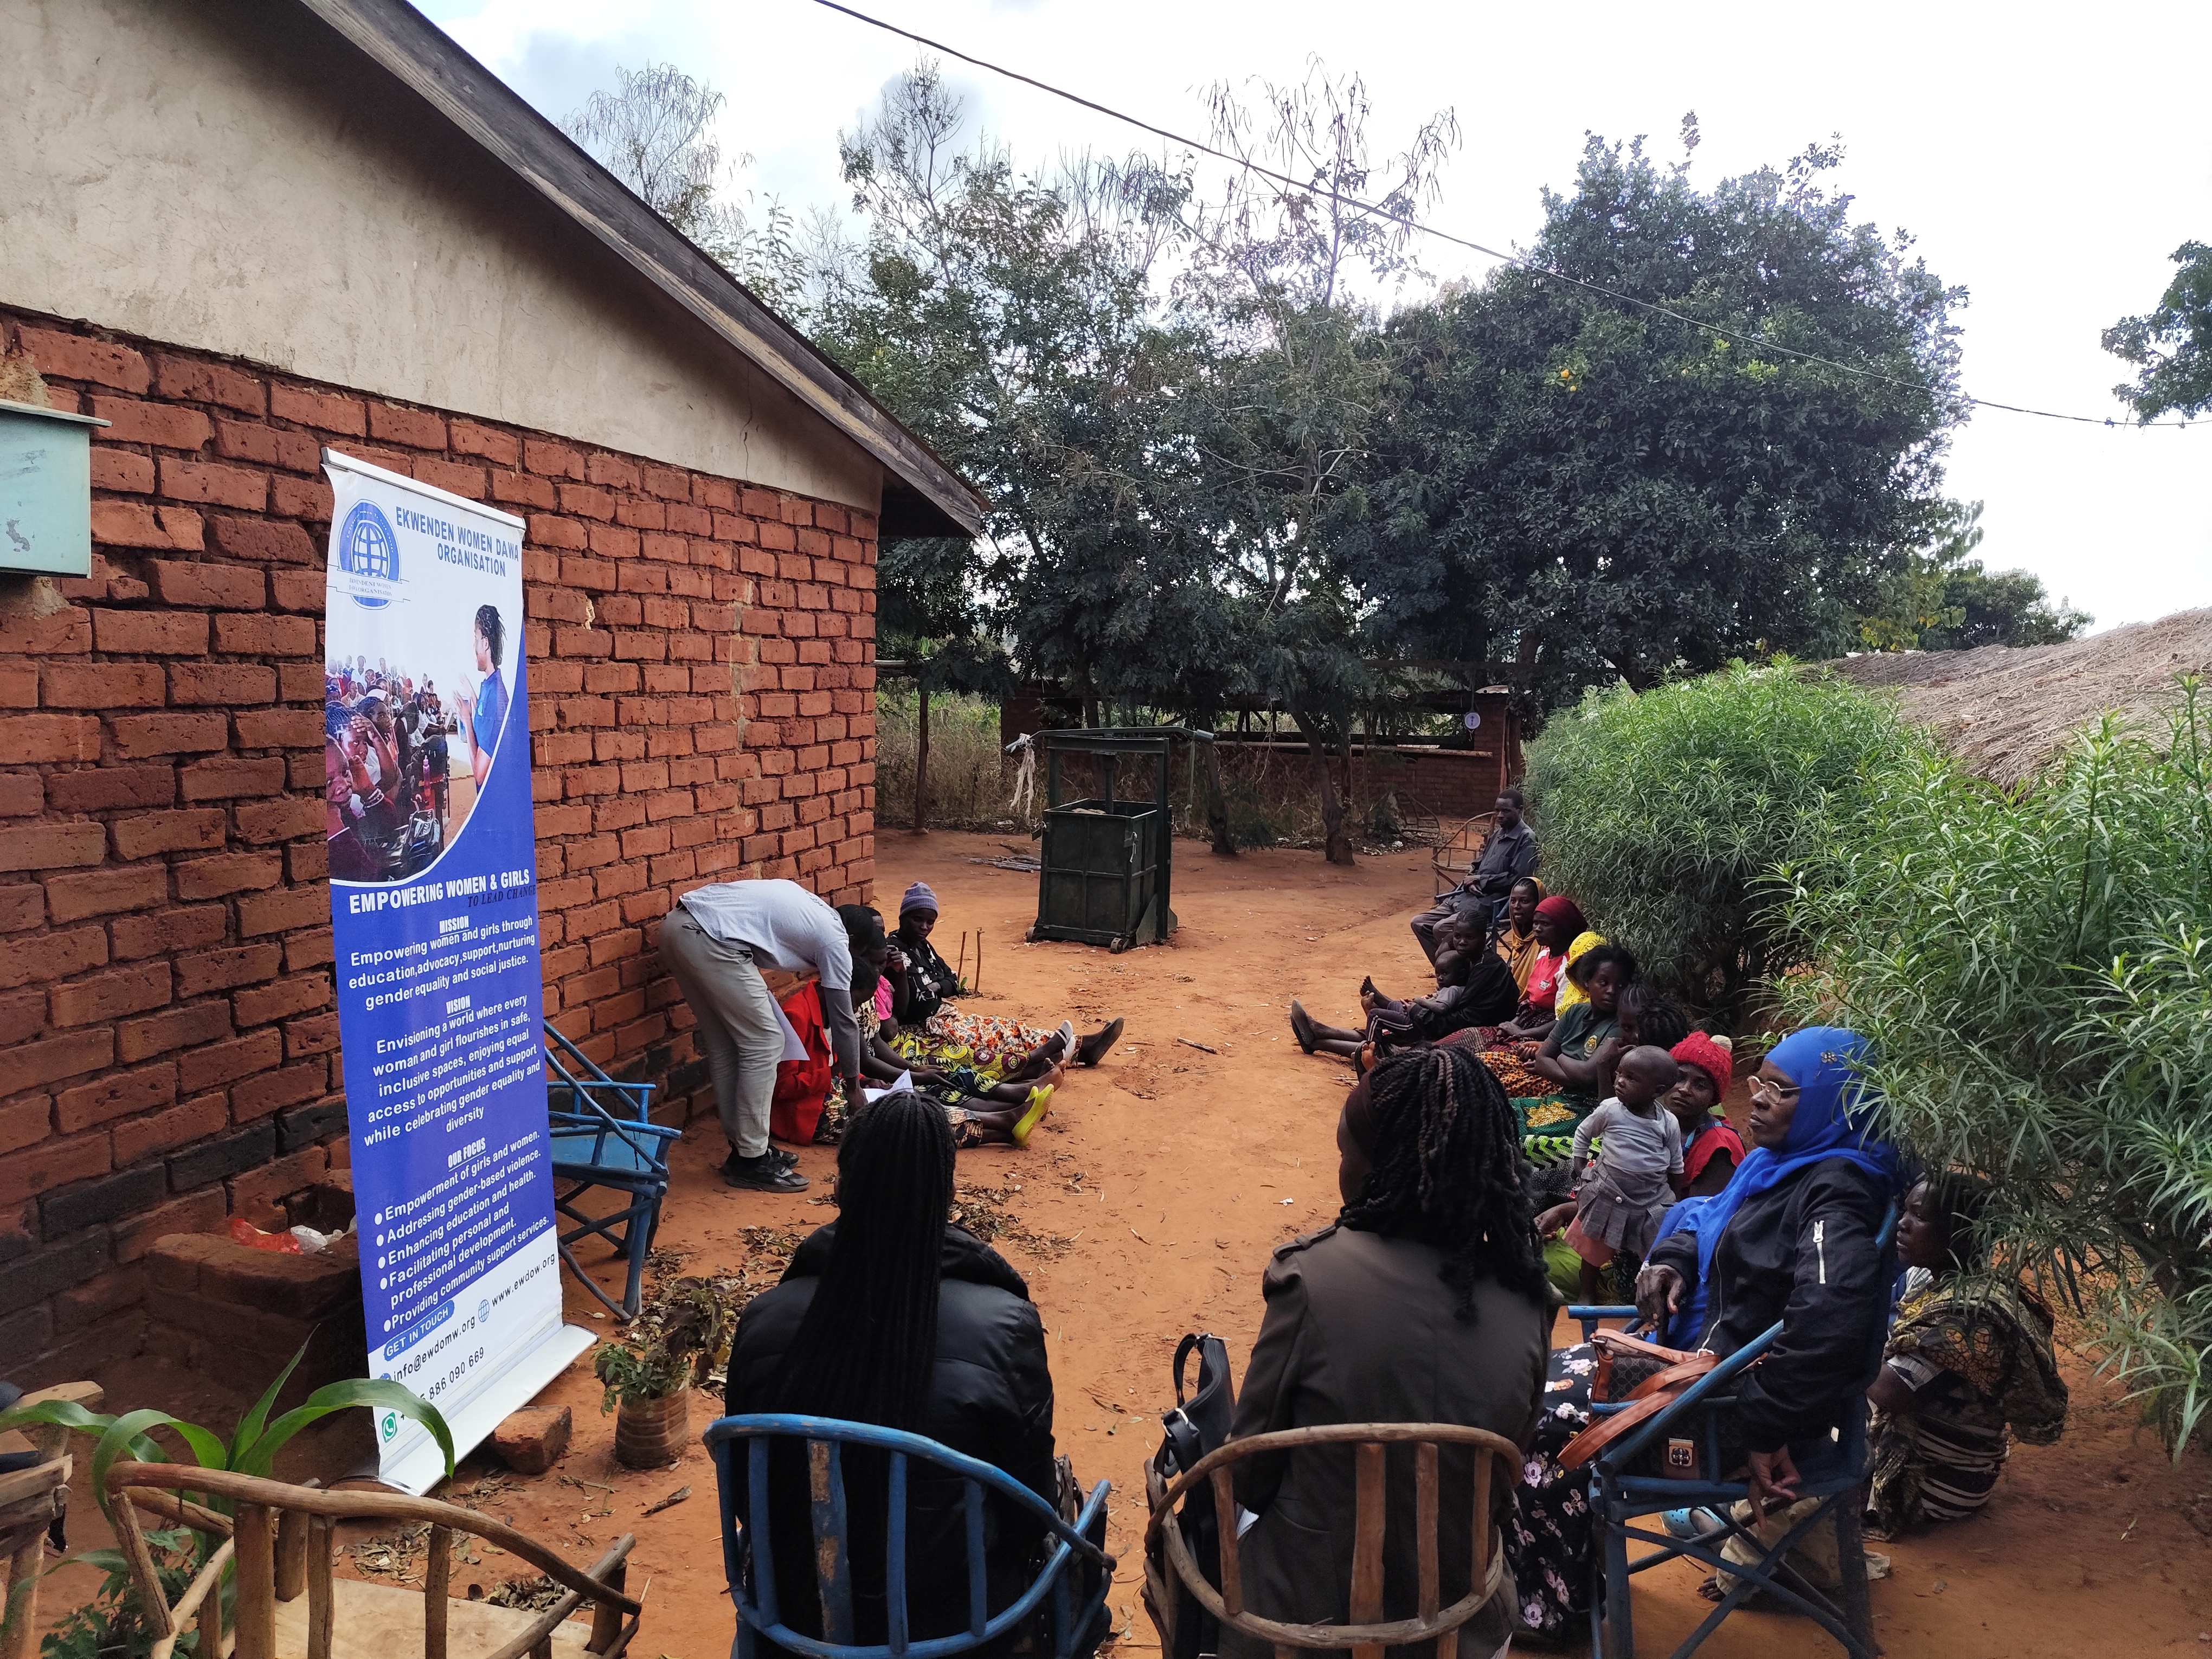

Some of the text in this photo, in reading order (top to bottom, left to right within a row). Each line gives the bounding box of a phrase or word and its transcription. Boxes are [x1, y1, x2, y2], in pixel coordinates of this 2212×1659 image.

[396, 506, 519, 562] EKWENDEN WOMEN DAWA
[438, 543, 505, 577] ORGANISATION
[349, 869, 529, 914] EMPOWERING WOMEN & GIRLS
[468, 884, 536, 907] TO LEAD CHANGE
[351, 915, 532, 966] Empowering women and girls through
[439, 916, 469, 934] MISSION
[365, 954, 529, 1011] gender equality and social justice.
[446, 995, 471, 1014] VISION
[372, 1012, 530, 1077] woman and girl flourishes in safe,
[376, 995, 527, 1054] Envisioning a world where every
[368, 1044, 537, 1122] access to opportunities and support
[378, 1028, 529, 1097] inclusive spaces, enjoying equal
[364, 1059, 540, 1146] while celebrating gender equality and
[446, 1107, 484, 1133] diversity
[385, 1130, 540, 1220] Empowerment of girls and women.
[448, 1137, 486, 1168] OUR FOCUS
[387, 1149, 541, 1244] Addressing gender-based violence.
[389, 1169, 536, 1265] Enhancing education and health.
[389, 1201, 509, 1287] Facilitating personal and
[391, 1217, 517, 1310] professional development.
[392, 1216, 549, 1329] Providing community support services.
[387, 1307, 448, 1356] GET IN TOUCH
[394, 1253, 555, 1382] info@ewdomw.org www.ewdow.org
[429, 1347, 484, 1400] 886 090 669
